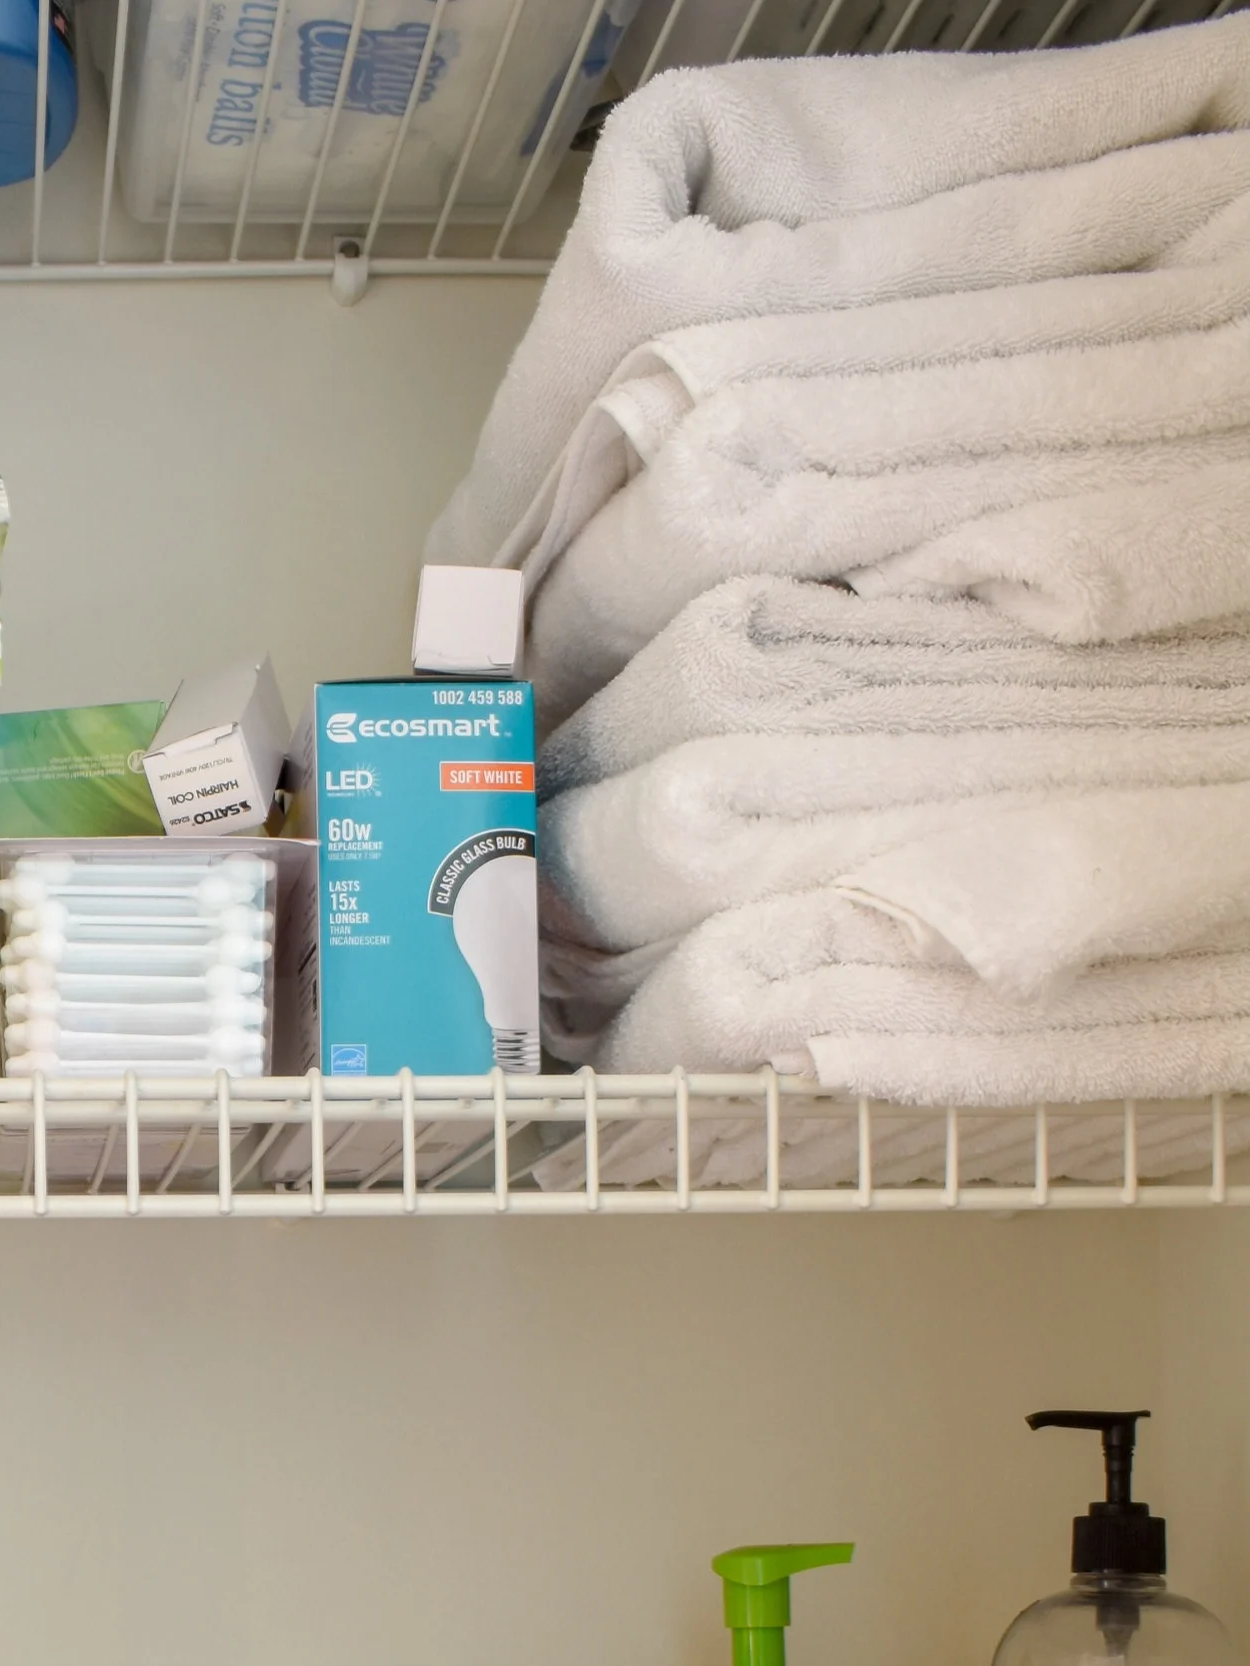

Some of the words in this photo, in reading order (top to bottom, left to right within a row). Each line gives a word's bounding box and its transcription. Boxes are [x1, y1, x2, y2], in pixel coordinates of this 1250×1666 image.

[433, 691, 464, 704] 1002
[468, 691, 494, 704] 459
[498, 691, 523, 704] 588
[358, 714, 501, 737] ecosmart
[326, 771, 373, 790] LED
[450, 770, 481, 784] SOFT
[484, 770, 523, 784] WHITE
[197, 779, 239, 799] HAIRPIN
[167, 791, 194, 805] COIL
[194, 801, 241, 825] SATCO
[328, 841, 383, 850] REPLACEMENT
[436, 860, 465, 904] CLASSIC
[461, 838, 495, 864] GLASS
[497, 836, 526, 850] BULB
[329, 881, 360, 892] LASTS
[330, 894, 357, 910] 15x
[330, 913, 369, 924] LONGER
[330, 926, 351, 934] THAN
[330, 936, 390, 945] INCANDESCENT
